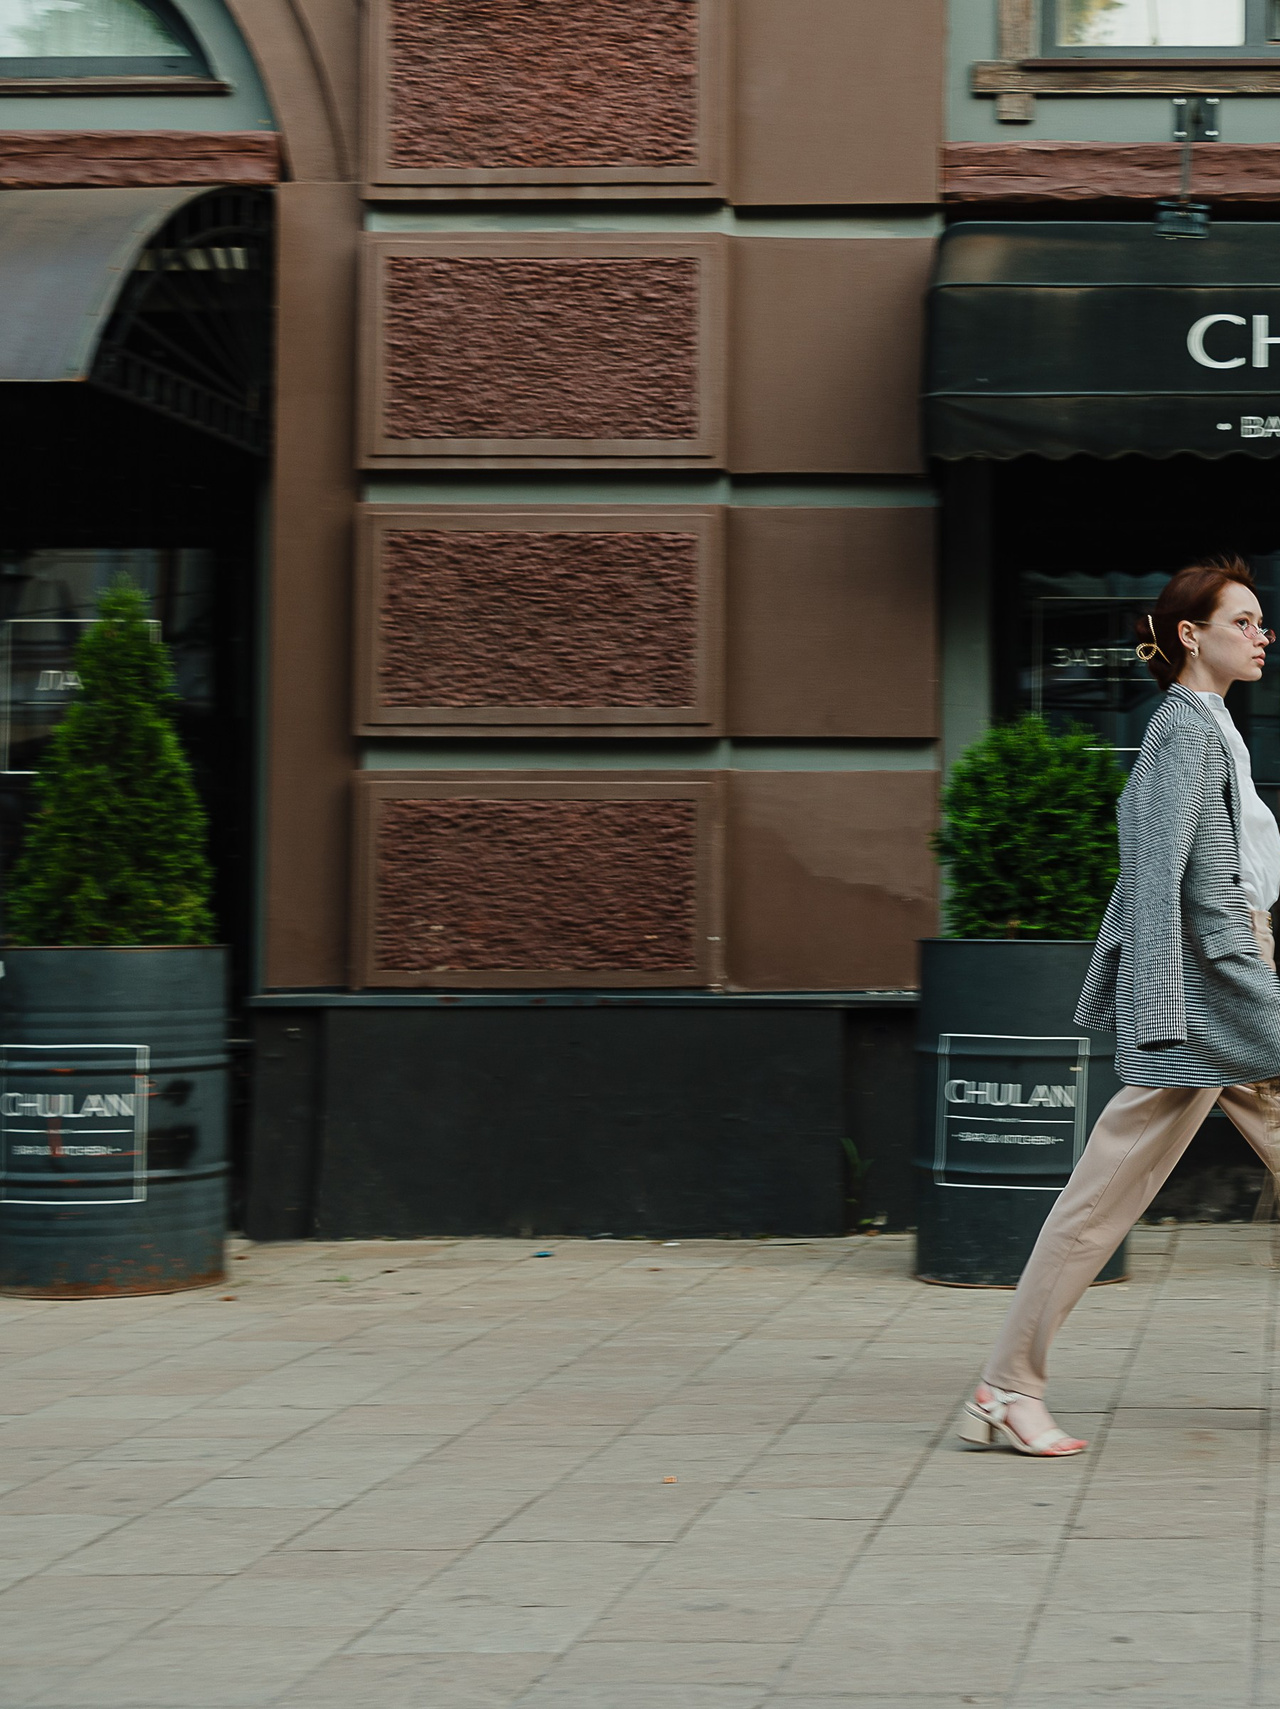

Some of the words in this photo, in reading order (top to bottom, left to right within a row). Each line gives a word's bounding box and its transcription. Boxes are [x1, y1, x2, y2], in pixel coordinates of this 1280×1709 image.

[1050, 647, 1149, 668] ЗАВТР
[0, 1092, 135, 1118] CHULAN
[944, 1079, 1077, 1108] CHULAN
